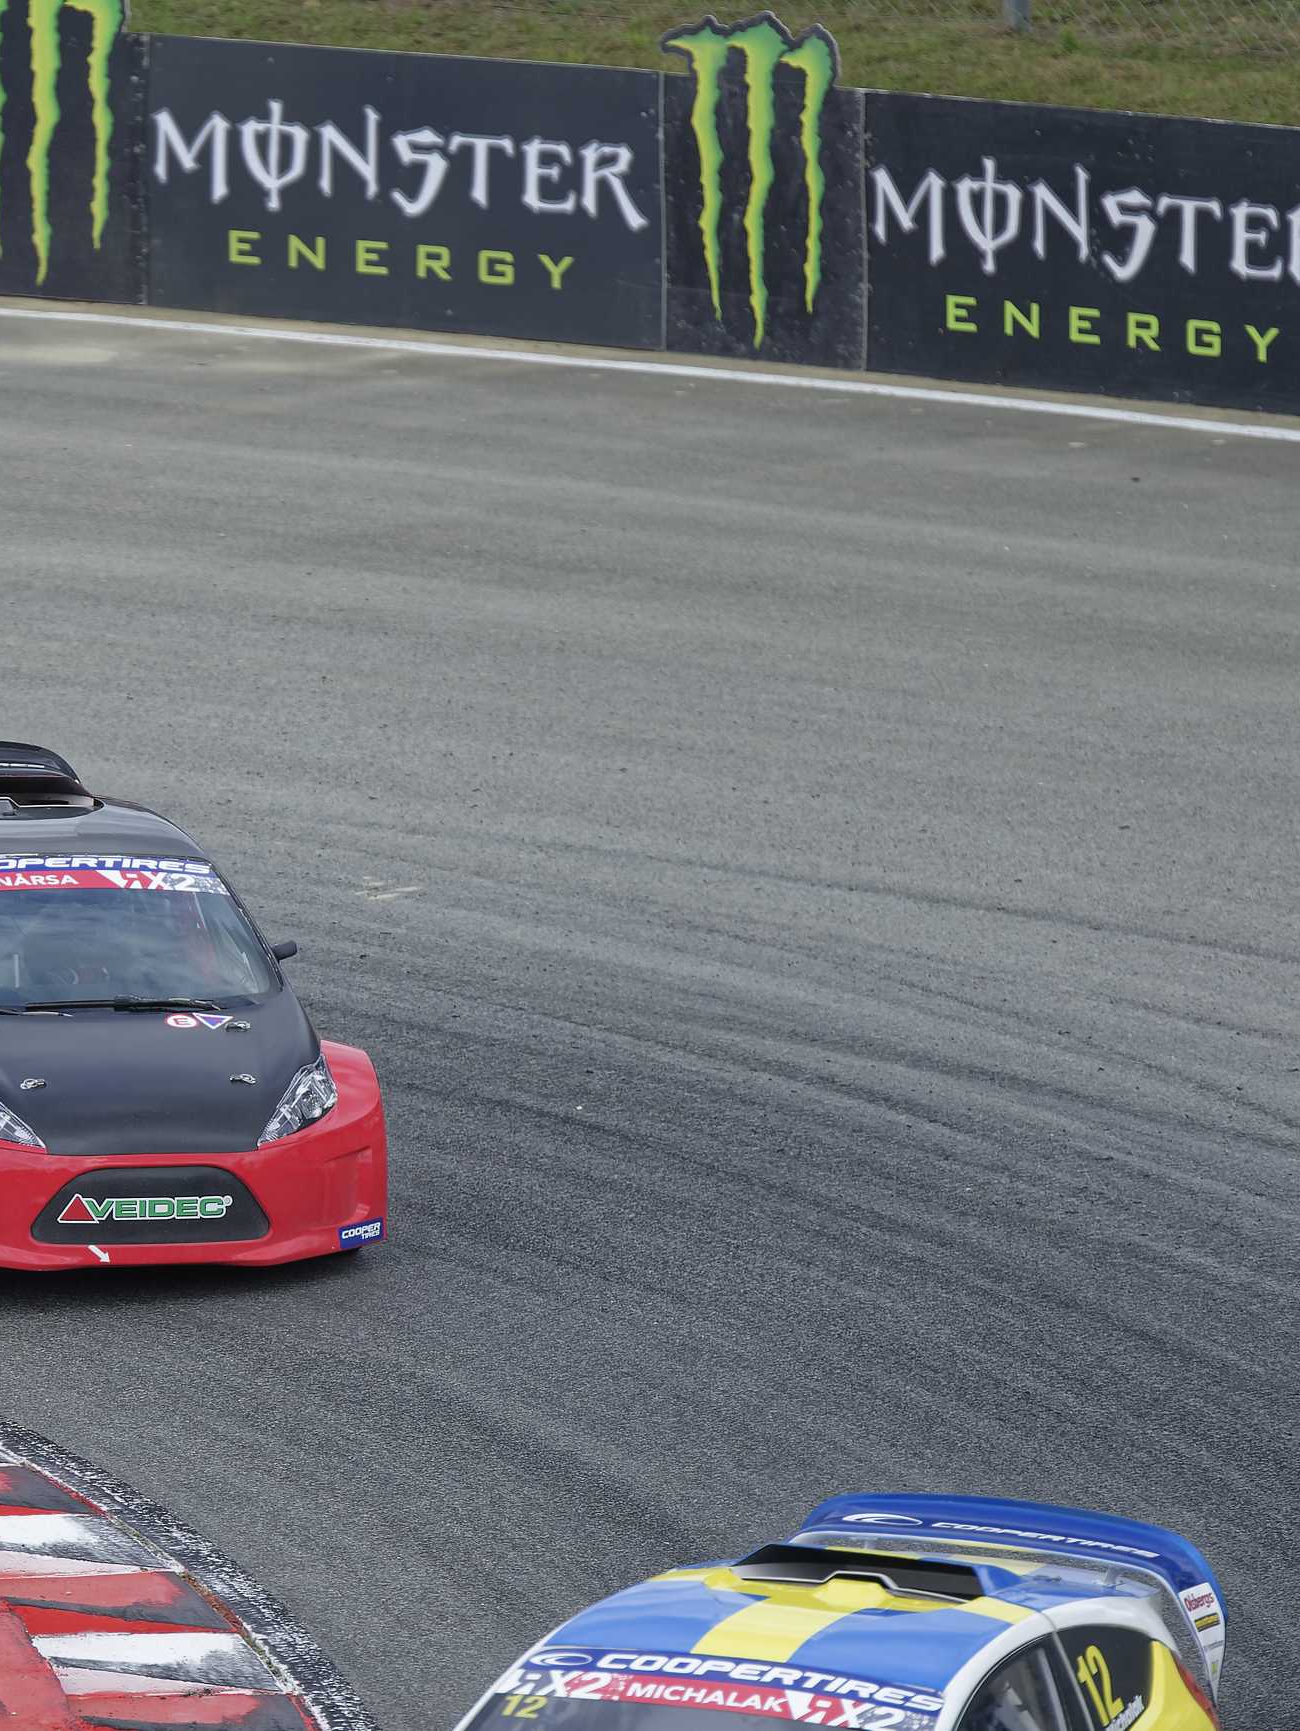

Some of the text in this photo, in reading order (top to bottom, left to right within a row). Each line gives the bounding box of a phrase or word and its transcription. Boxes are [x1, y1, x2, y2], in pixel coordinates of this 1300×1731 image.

[152, 100, 649, 231] MONSTER
[870, 156, 1300, 282] MONSTE
[227, 229, 574, 289] ENERGY
[945, 294, 1280, 363] ENERGY
[341, 1222, 381, 1239] COOPER
[501, 1695, 548, 1719] 12
[626, 1682, 789, 1713] MICHALAK
[1077, 1645, 1125, 1727] 12
